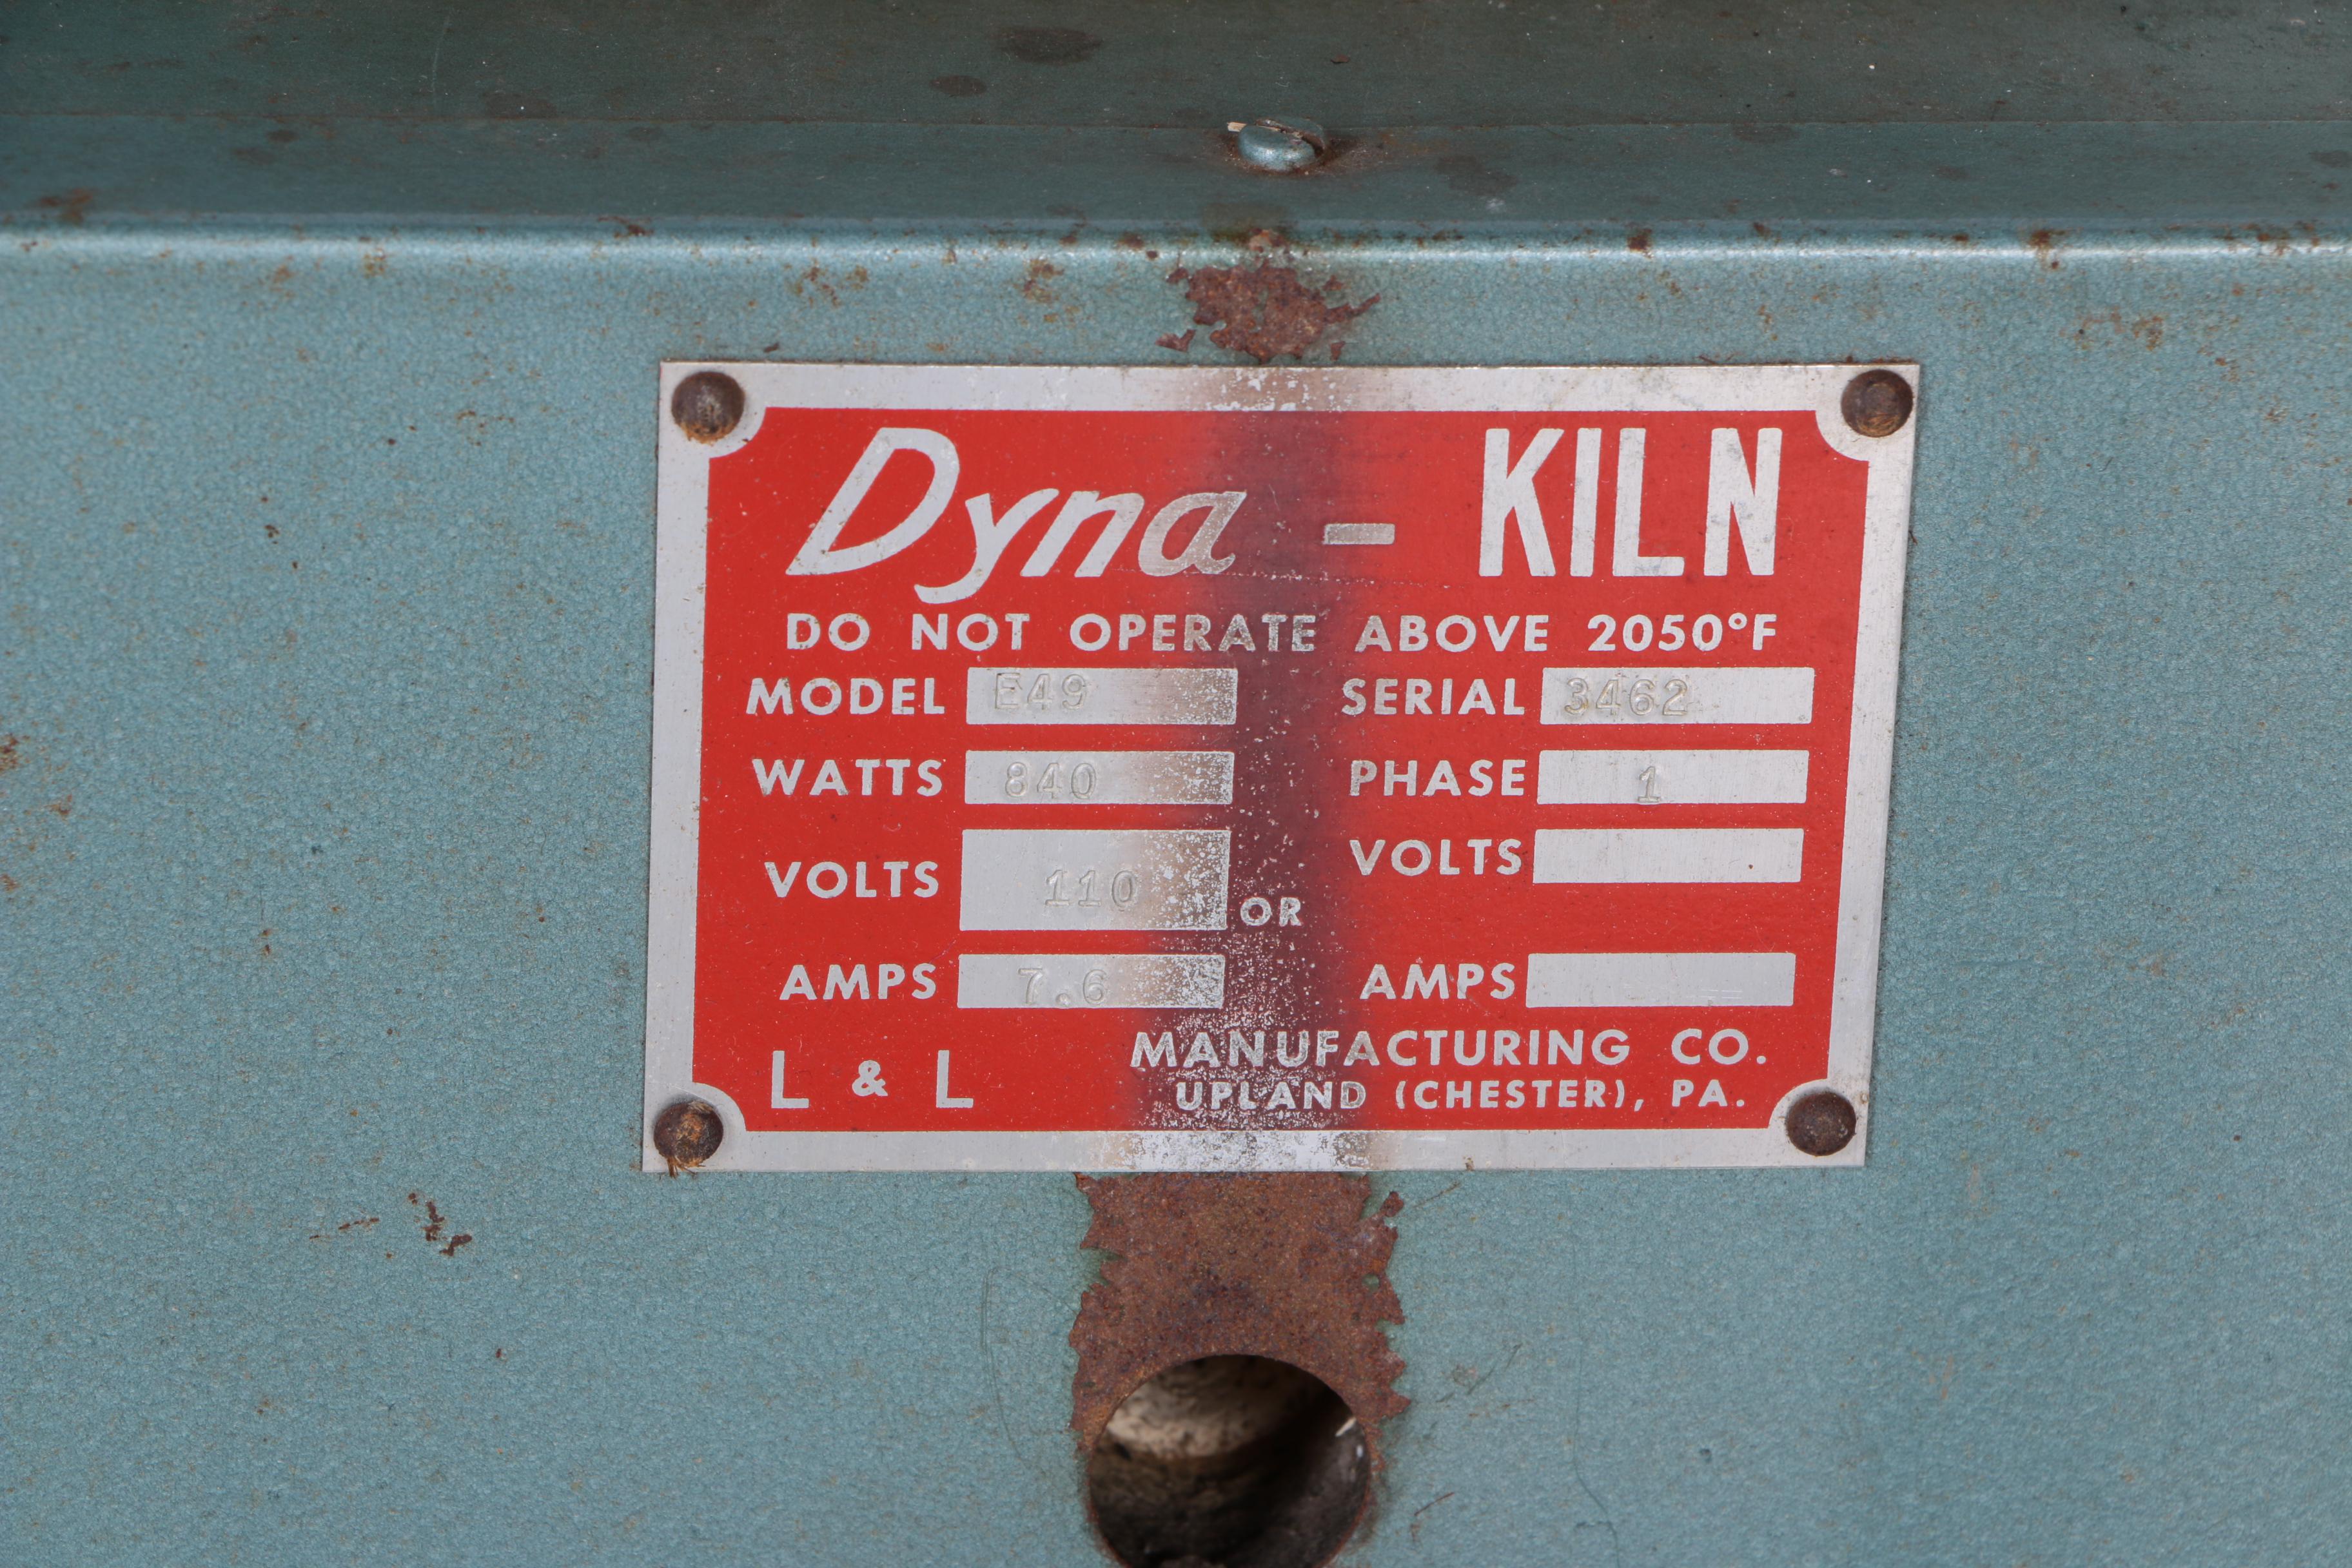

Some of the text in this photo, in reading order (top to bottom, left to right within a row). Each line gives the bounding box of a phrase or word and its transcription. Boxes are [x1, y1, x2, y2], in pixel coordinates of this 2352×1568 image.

[786, 427, 1247, 603] Dyna
[1479, 427, 1783, 576] KILN
[786, 612, 1777, 651] DO NOT OPERATE ABOVE 2050°F
[746, 673, 1089, 715] MODEL E49
[1342, 678, 1690, 716] SERIAL 3462
[752, 759, 1097, 799] WATTS 840
[1349, 759, 1661, 803] PHASE 1
[1349, 838, 1522, 876] VOLTS
[765, 861, 1139, 911] VOLTS 110
[1240, 897, 1302, 926] OR
[779, 963, 1109, 1006] AMPS 7.6
[1360, 963, 1516, 1000] AMPS
[771, 1028, 1767, 1108] L & L MANUFACTURING CO.
[1176, 1079, 1746, 1112] UPLAND (CHESTER), PA.
